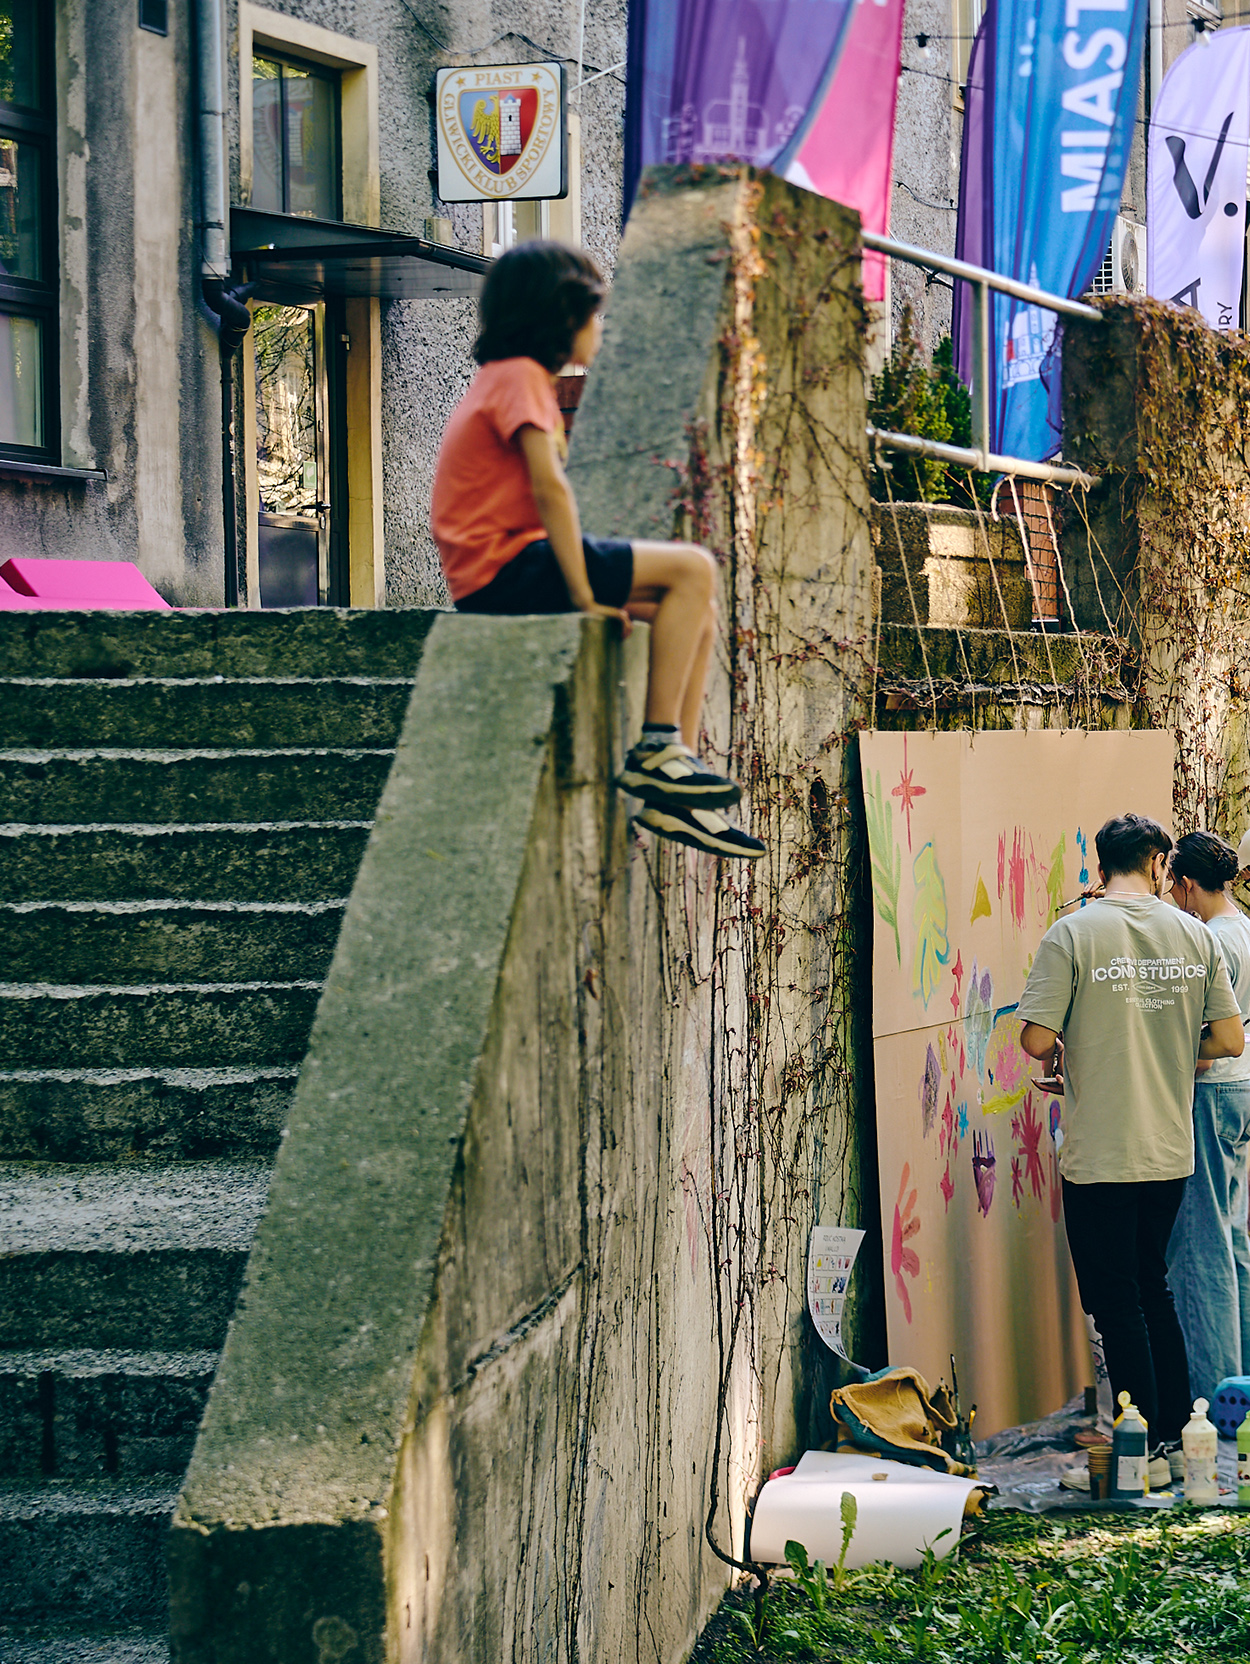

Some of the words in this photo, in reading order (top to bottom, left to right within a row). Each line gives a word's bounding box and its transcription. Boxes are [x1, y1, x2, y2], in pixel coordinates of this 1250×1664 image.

[474, 71, 524, 87] PIAST
[443, 93, 477, 173] GLIWICKI
[472, 170, 518, 194] KLUB
[519, 86, 555, 181] SPORTOWY
[1137, 957, 1185, 967] DEPARTMENT
[1138, 964, 1207, 980] STUDIOS
[1112, 983, 1130, 992] EST.
[1171, 985, 1189, 993] 1999
[1145, 997, 1175, 1005] CLOTHING
